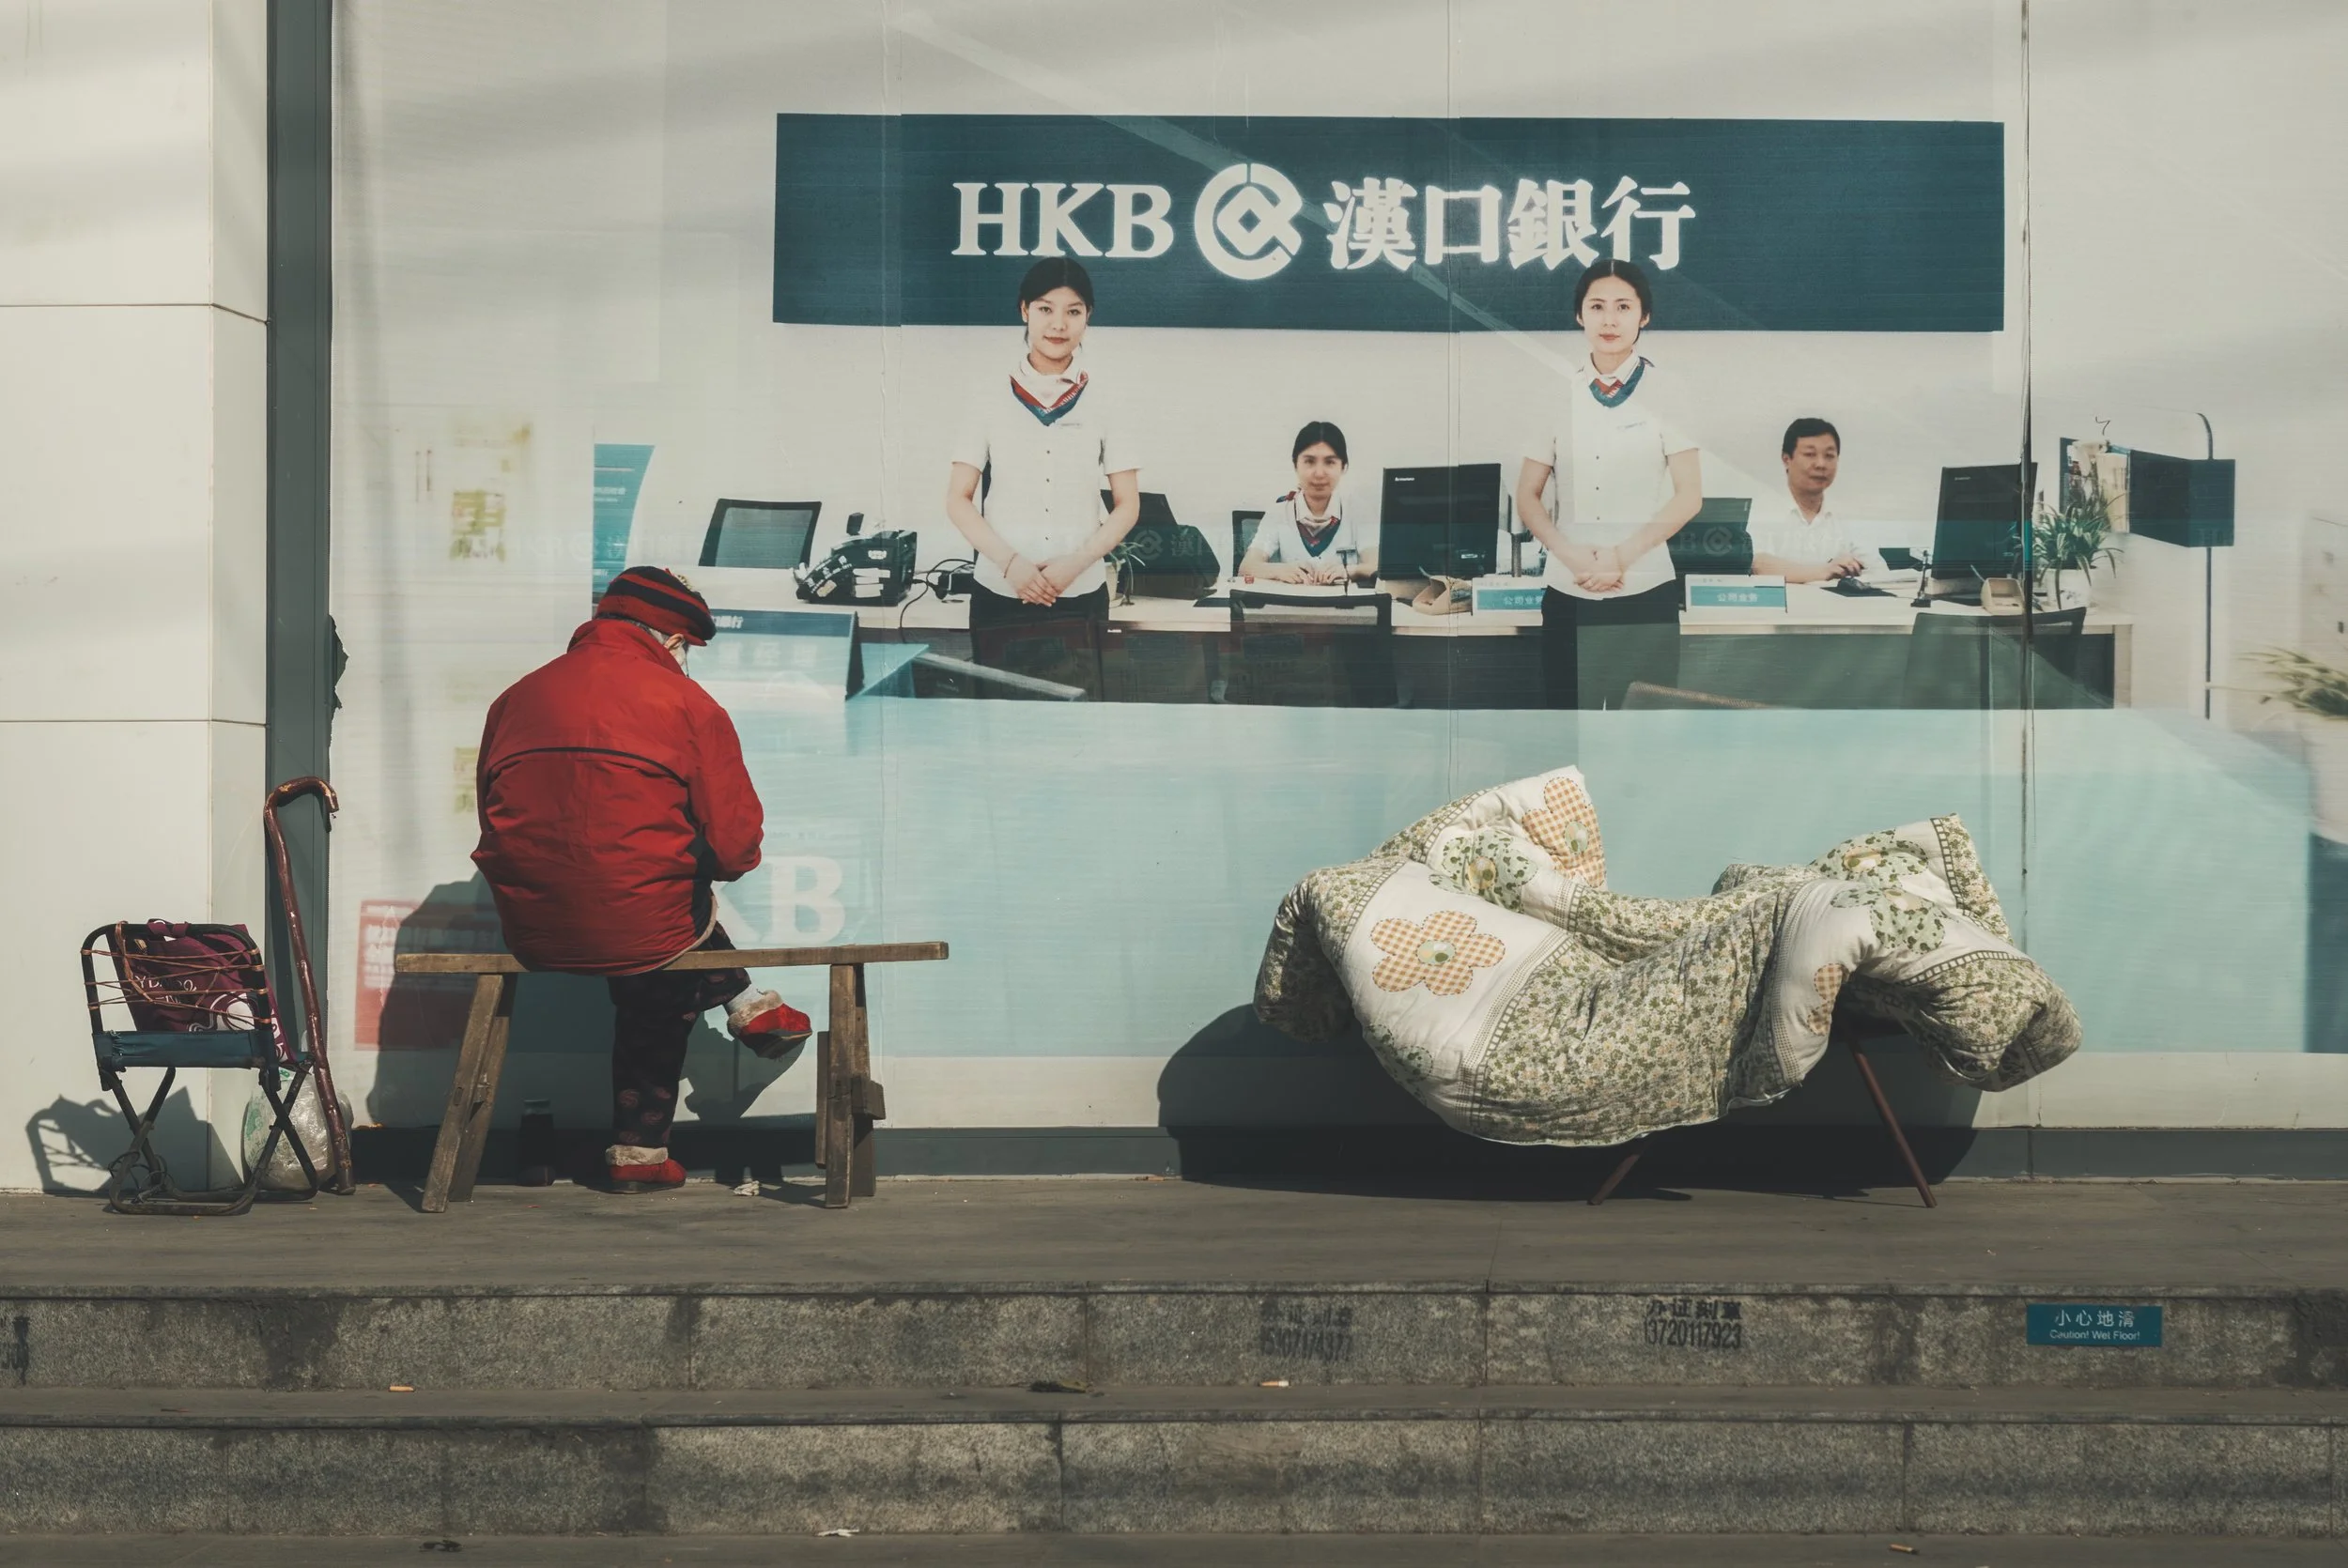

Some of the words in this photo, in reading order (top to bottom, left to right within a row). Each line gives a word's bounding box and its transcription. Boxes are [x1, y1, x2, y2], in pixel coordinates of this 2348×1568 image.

[951, 182, 1174, 258] HKB
[1322, 176, 1696, 271] 漢口銀行
[1644, 1315, 1742, 1349] 13720117923
[2049, 1330, 2090, 1340] Caution!
[2091, 1330, 2111, 1340] Wet
[2112, 1330, 2140, 1341] Floor!
[2054, 1309, 2136, 1328] 小心地滑
